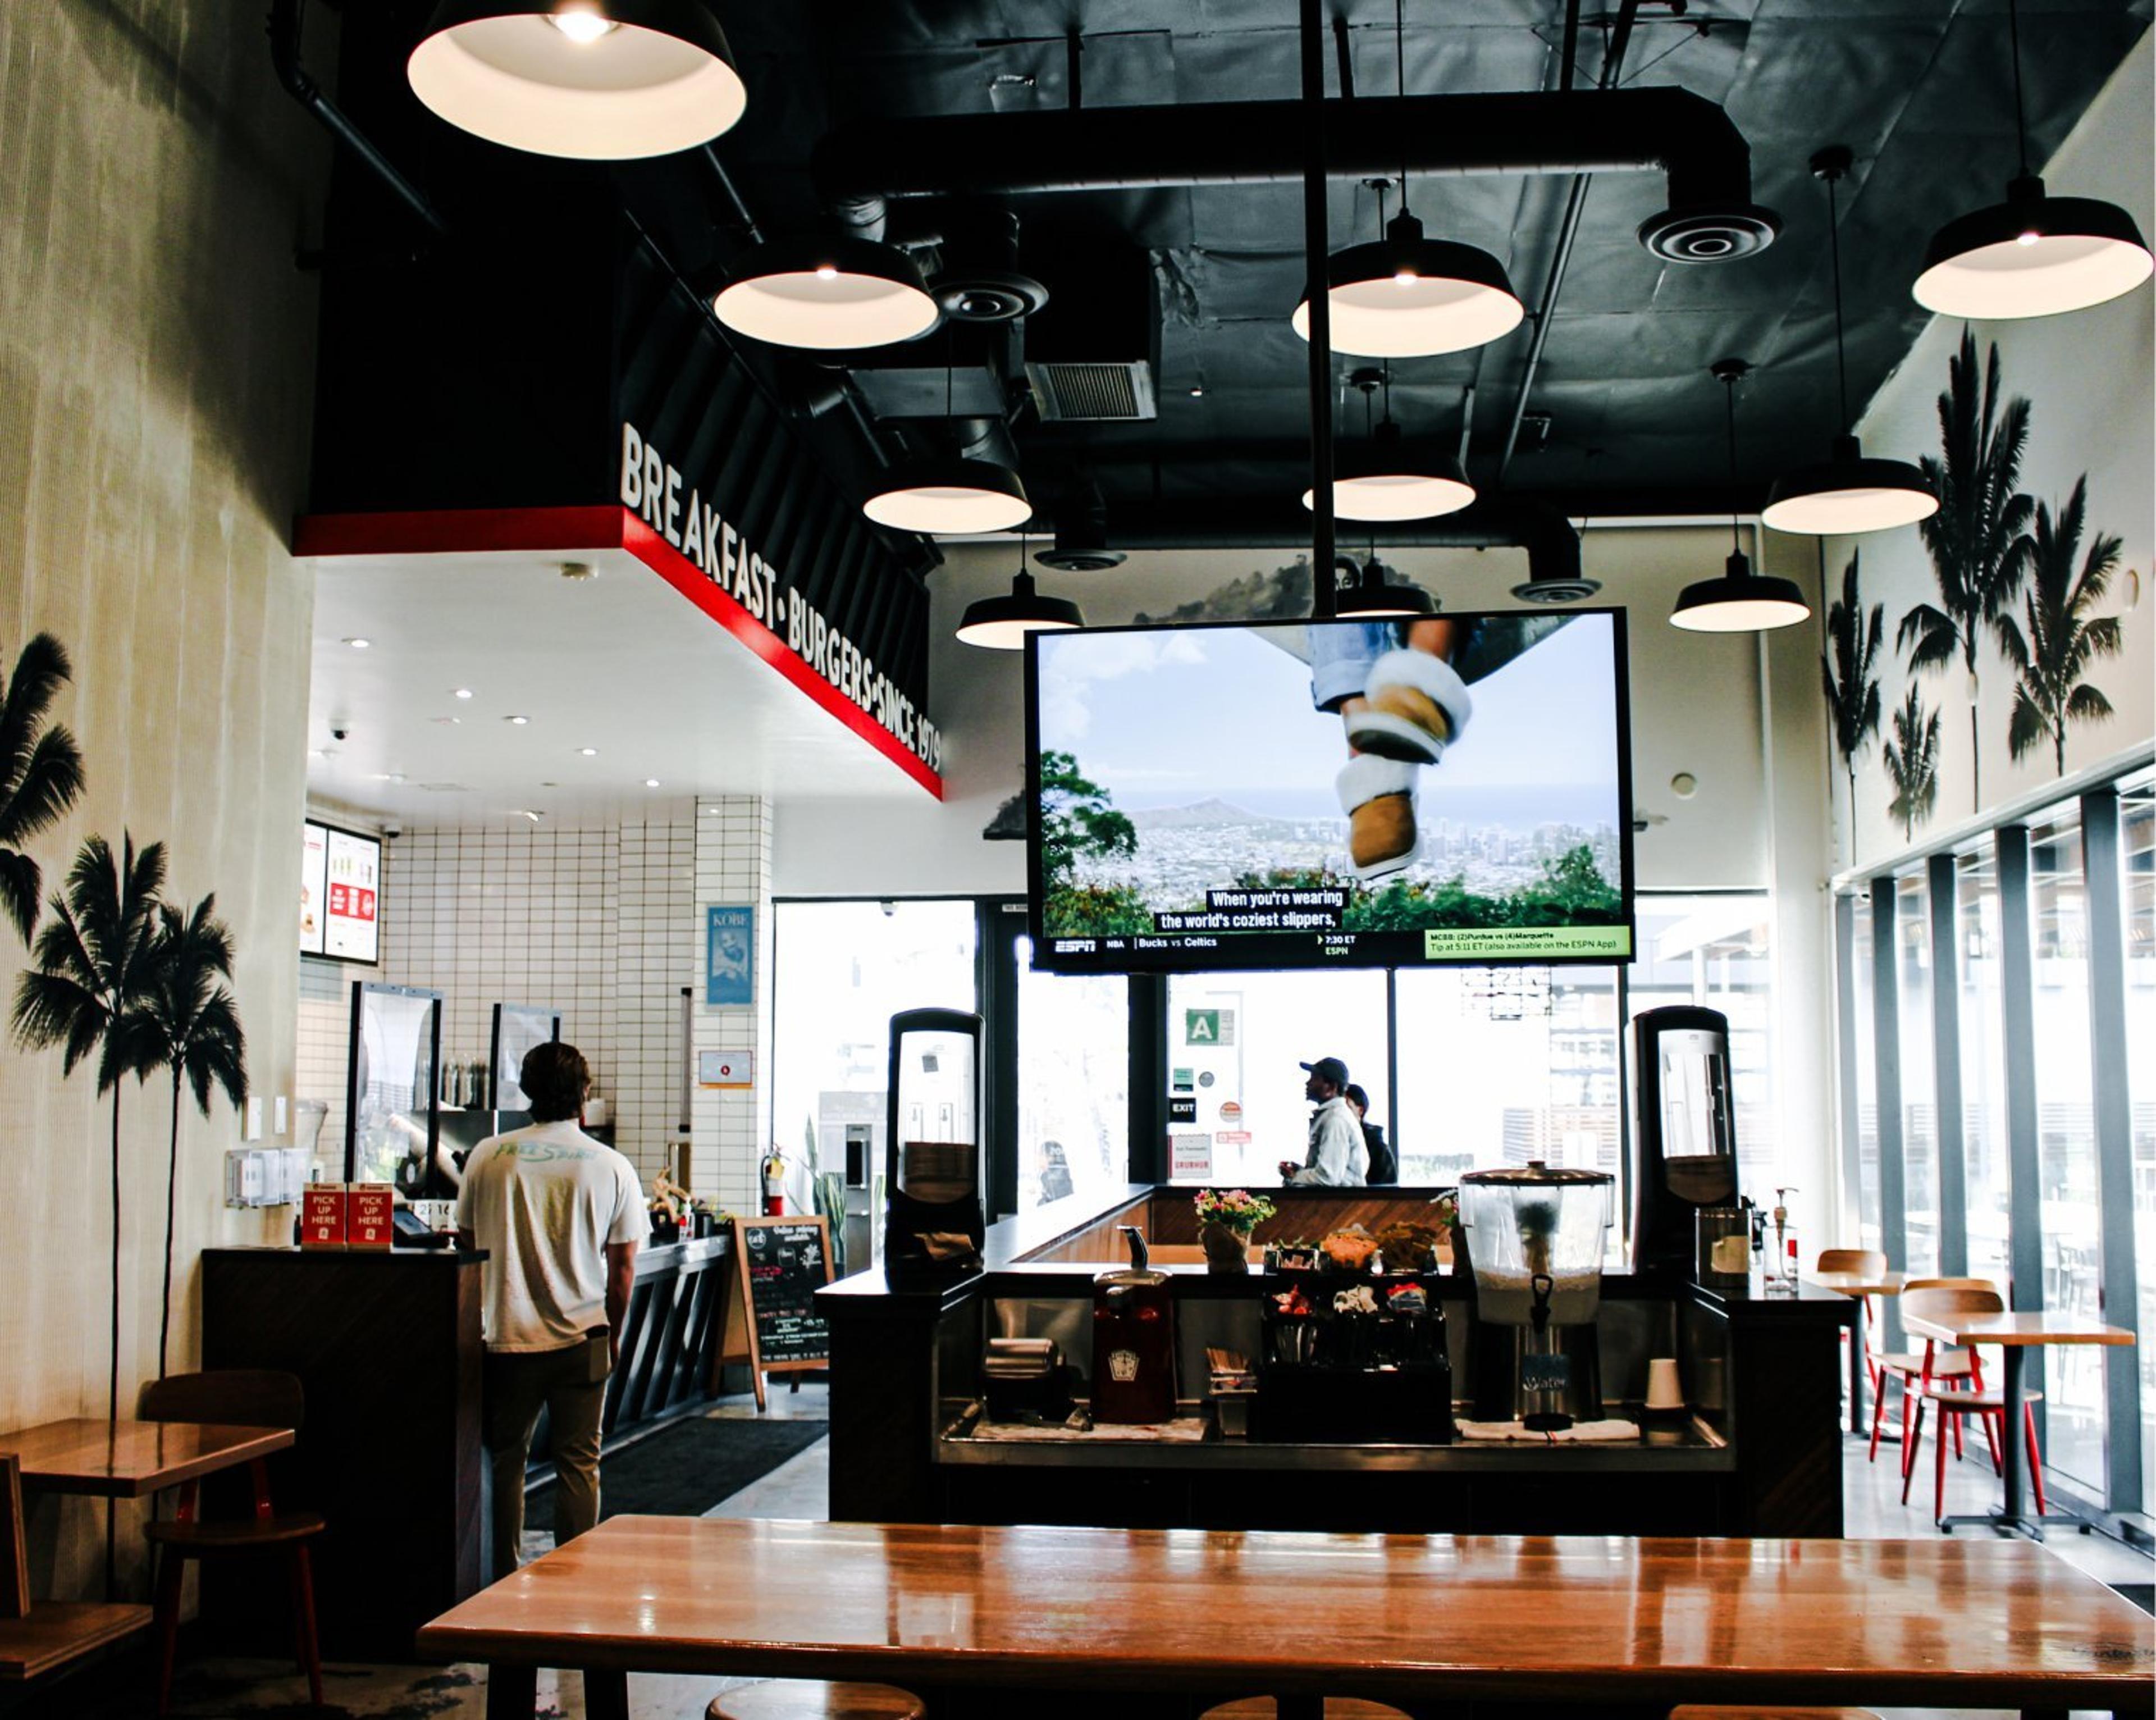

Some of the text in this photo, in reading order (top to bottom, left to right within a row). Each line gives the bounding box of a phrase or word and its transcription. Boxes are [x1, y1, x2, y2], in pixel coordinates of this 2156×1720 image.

[621, 422, 941, 772] BREAKFAST BURGERS SINCE 1979
[1212, 890, 1343, 909] When you're wearing
[713, 913, 748, 927] KOBE
[1161, 911, 1336, 929] the world's coziest slippers,
[1106, 940, 1125, 948] NBA
[1139, 938, 1168, 948] Bucks
[1184, 937, 1217, 947] Celtics
[1344, 935, 1356, 944] ET
[1055, 939, 1096, 953] ESPN
[1431, 943, 1444, 952] Tip
[1506, 941, 1542, 950] available
[1325, 947, 1349, 955] ESPN
[1191, 1016, 1213, 1039] A
[1172, 1103, 1194, 1112] EXIT
[312, 1196, 336, 1205] PICK
[359, 1197, 383, 1206] PICK
[318, 1206, 331, 1215] UP
[364, 1207, 378, 1215] UP
[312, 1216, 337, 1225] HERE
[358, 1217, 384, 1226] HERE
